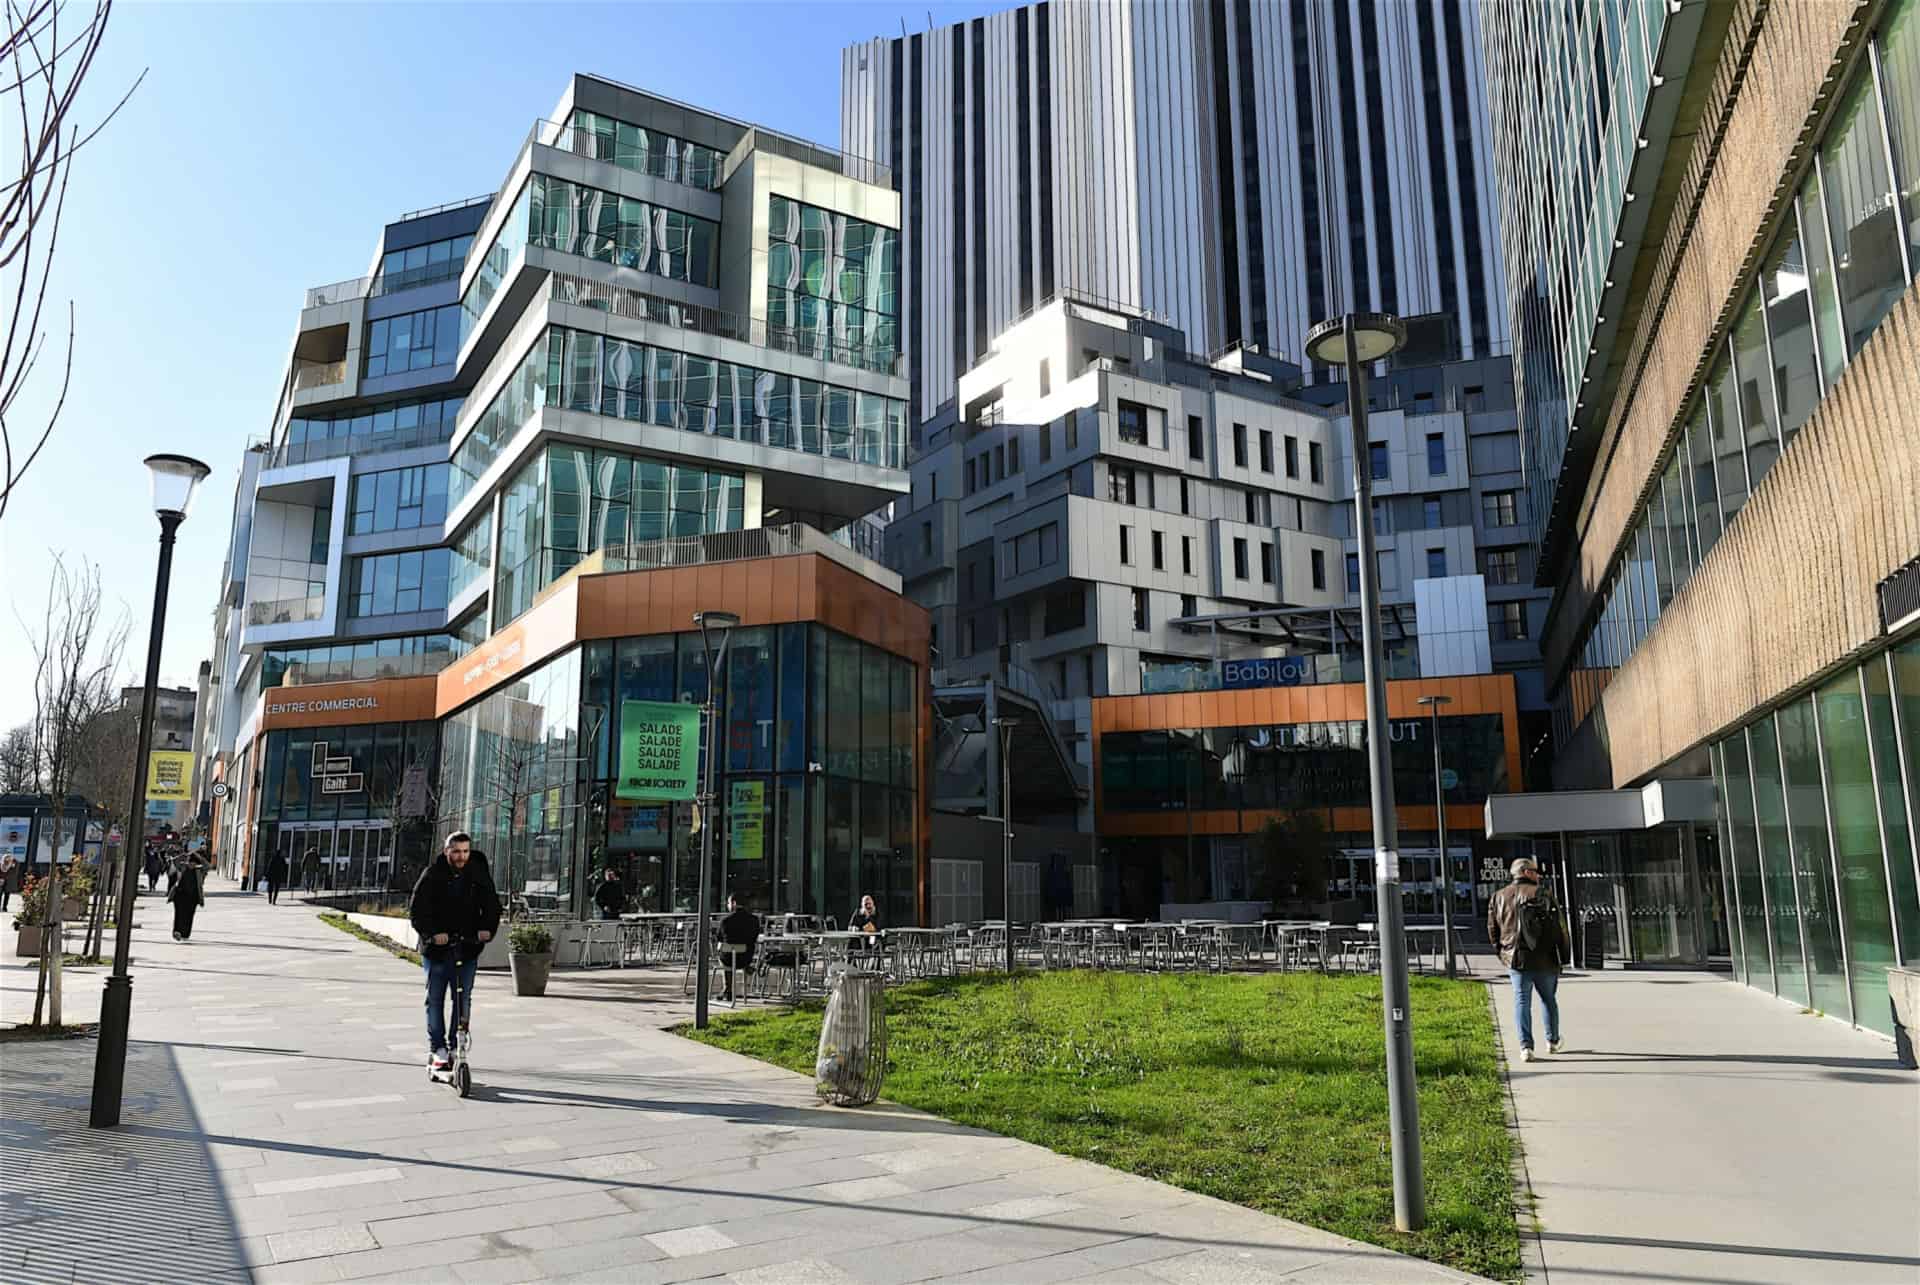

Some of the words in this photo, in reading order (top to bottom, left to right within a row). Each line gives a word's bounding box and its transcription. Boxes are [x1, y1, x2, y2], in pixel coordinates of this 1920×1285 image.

[1225, 660, 1310, 682] Babilou
[265, 702, 305, 714] CENTRE
[308, 697, 378, 711] COMMERCIAL
[640, 723, 683, 735] SALADE
[1274, 722, 1421, 746] TRUFFUT
[640, 735, 682, 747] SALADE
[639, 747, 681, 759] SALADE
[638, 759, 681, 770] SALADE
